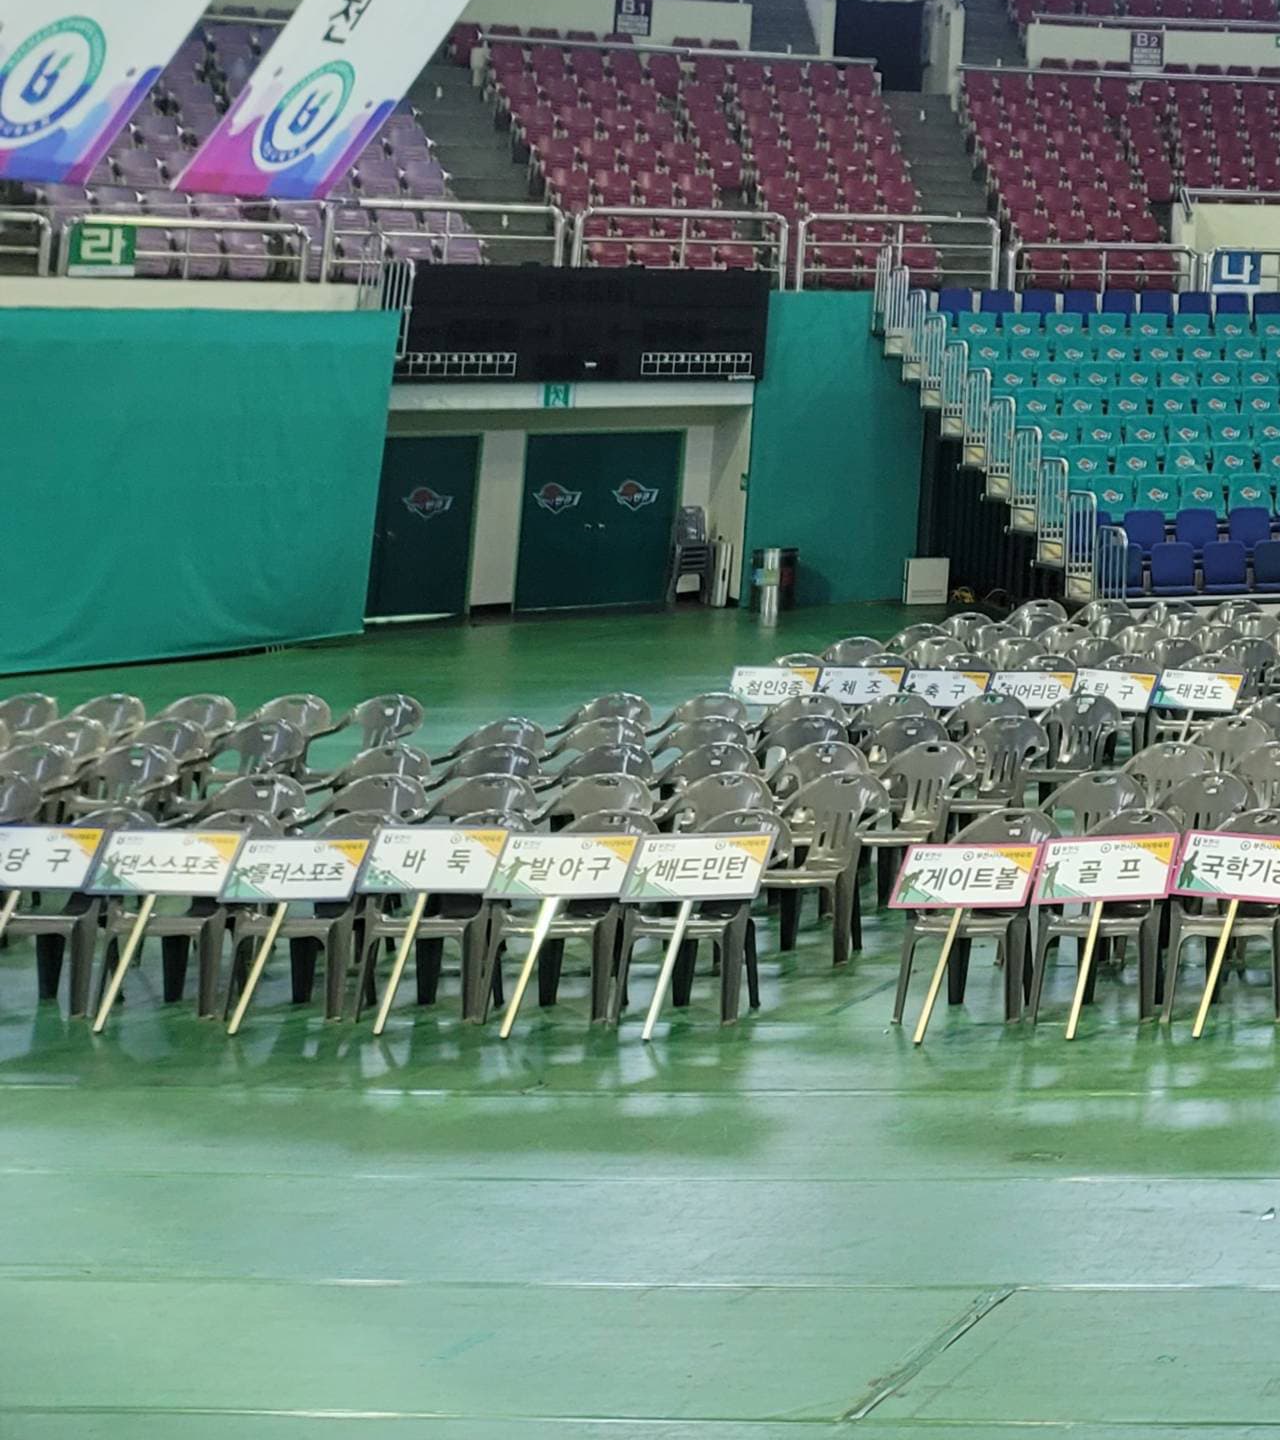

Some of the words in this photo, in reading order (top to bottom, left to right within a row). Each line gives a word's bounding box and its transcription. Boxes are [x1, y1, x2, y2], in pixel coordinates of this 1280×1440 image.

[1136, 32, 1159, 48] B2
[81, 227, 128, 265] 라
[1221, 254, 1254, 284] 나
[746, 679, 802, 696] 철인3종
[1176, 681, 1224, 701] 태권도
[121, 854, 219, 876] 댄스스포츠
[250, 862, 345, 884] 롤러스포츠
[529, 856, 613, 881] 발야구
[655, 855, 750, 881] 배드민턴
[922, 866, 1019, 892] 게이트볼
